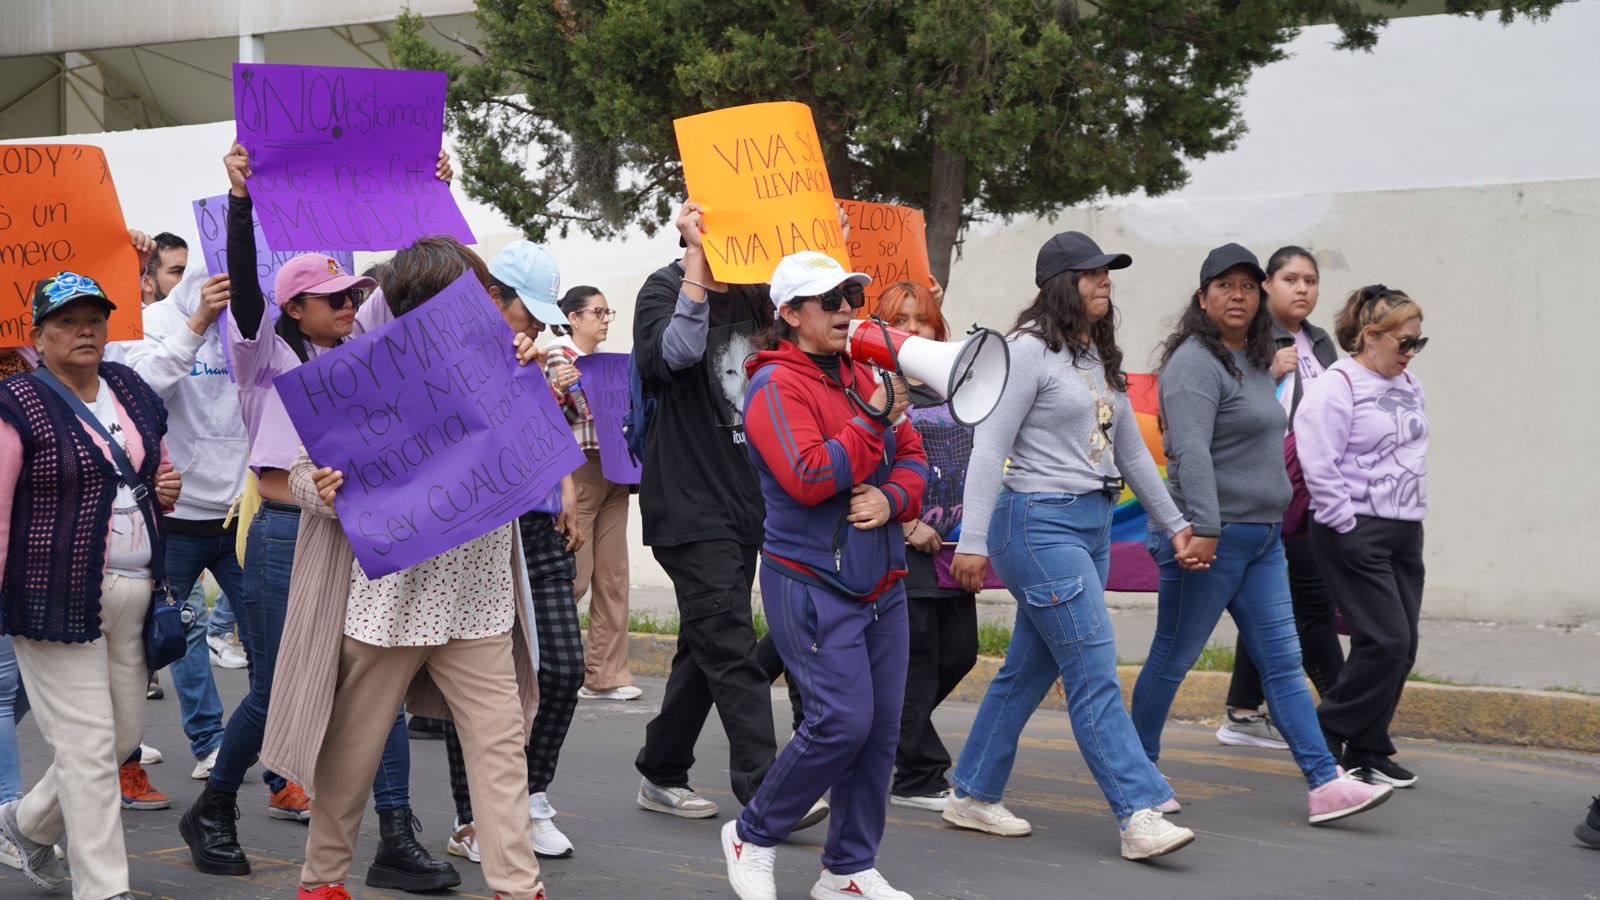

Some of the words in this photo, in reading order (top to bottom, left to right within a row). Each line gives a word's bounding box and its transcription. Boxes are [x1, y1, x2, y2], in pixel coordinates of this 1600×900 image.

[345, 87, 437, 135] estamos
[334, 161, 384, 195] nos
[713, 134, 796, 175] VIVA
[32, 202, 68, 228] un
[271, 197, 425, 247] MELODY
[708, 232, 770, 267] VIVA
[775, 221, 811, 258] LA
[878, 240, 901, 257] ser
[298, 333, 381, 416] HOY
[344, 391, 403, 447] Por
[423, 327, 509, 414] MELODY
[427, 404, 568, 523] CUALQUIERA
